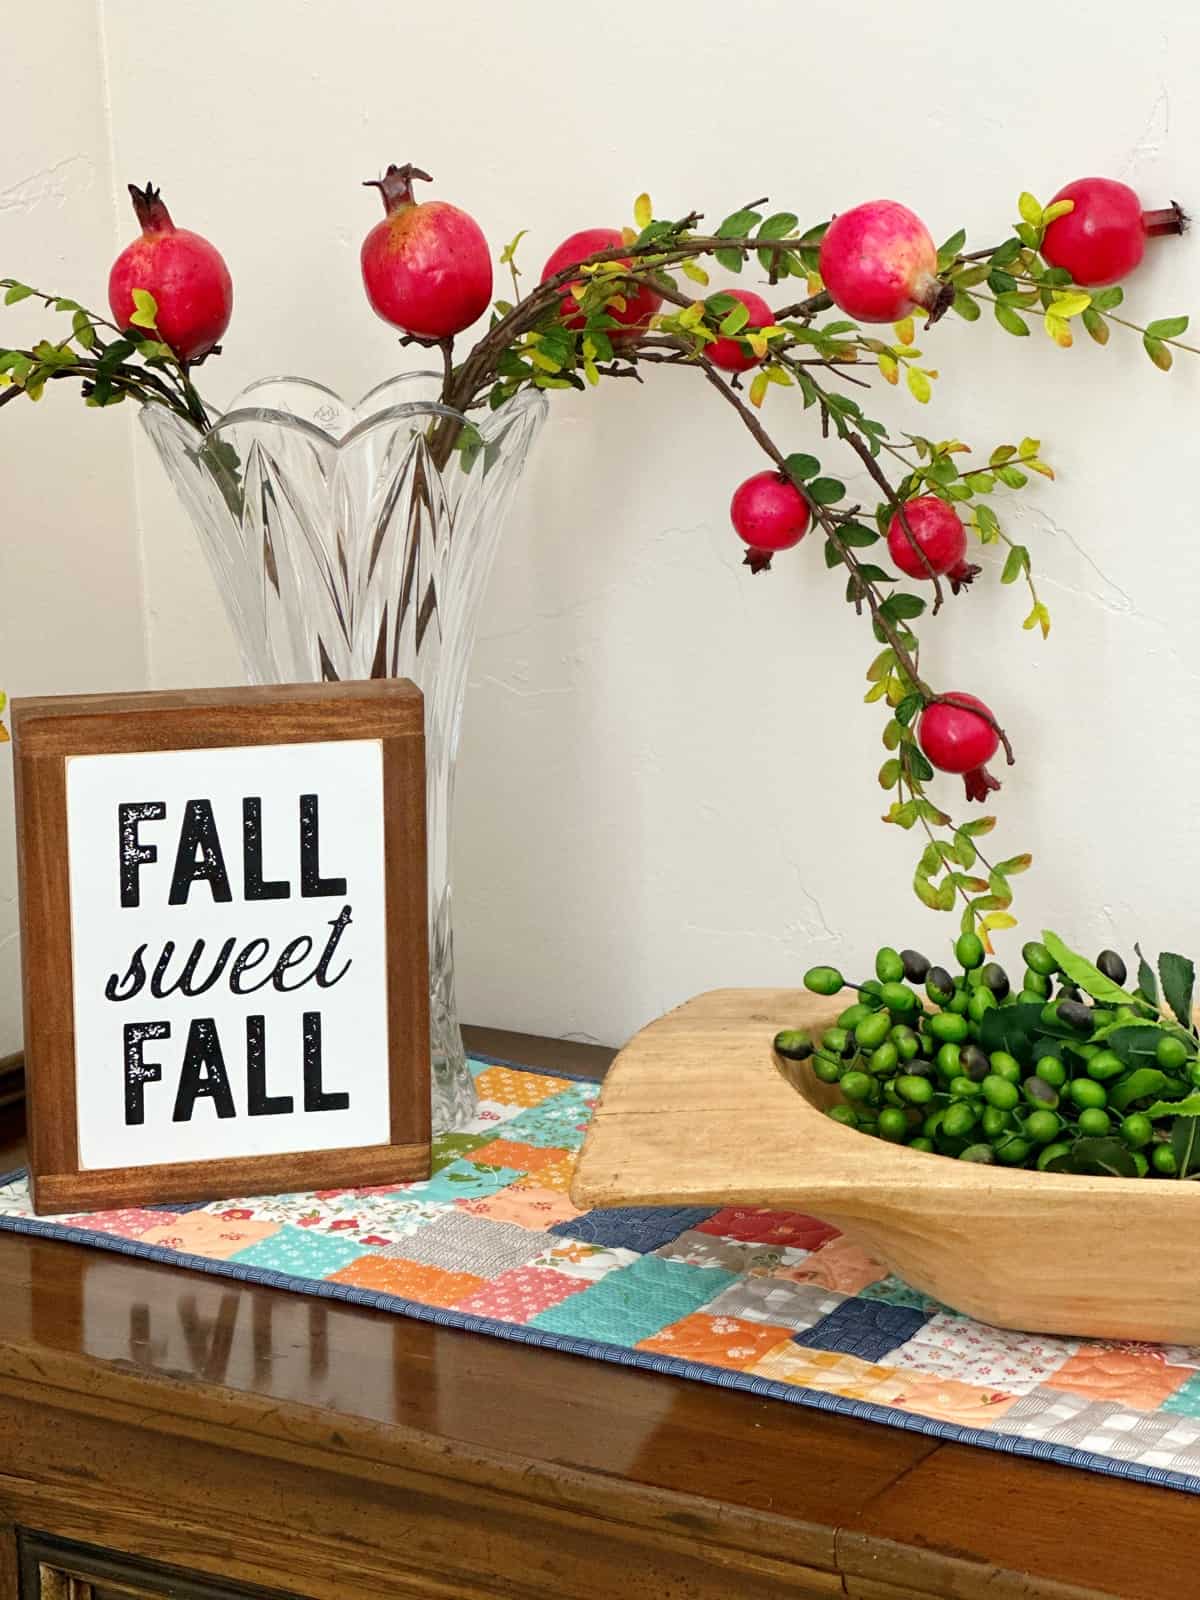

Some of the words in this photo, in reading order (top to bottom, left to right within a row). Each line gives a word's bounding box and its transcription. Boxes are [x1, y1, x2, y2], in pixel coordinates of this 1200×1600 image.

[119, 794, 347, 907] FALL
[105, 905, 353, 1001] sweet
[123, 1011, 350, 1125] FALL
